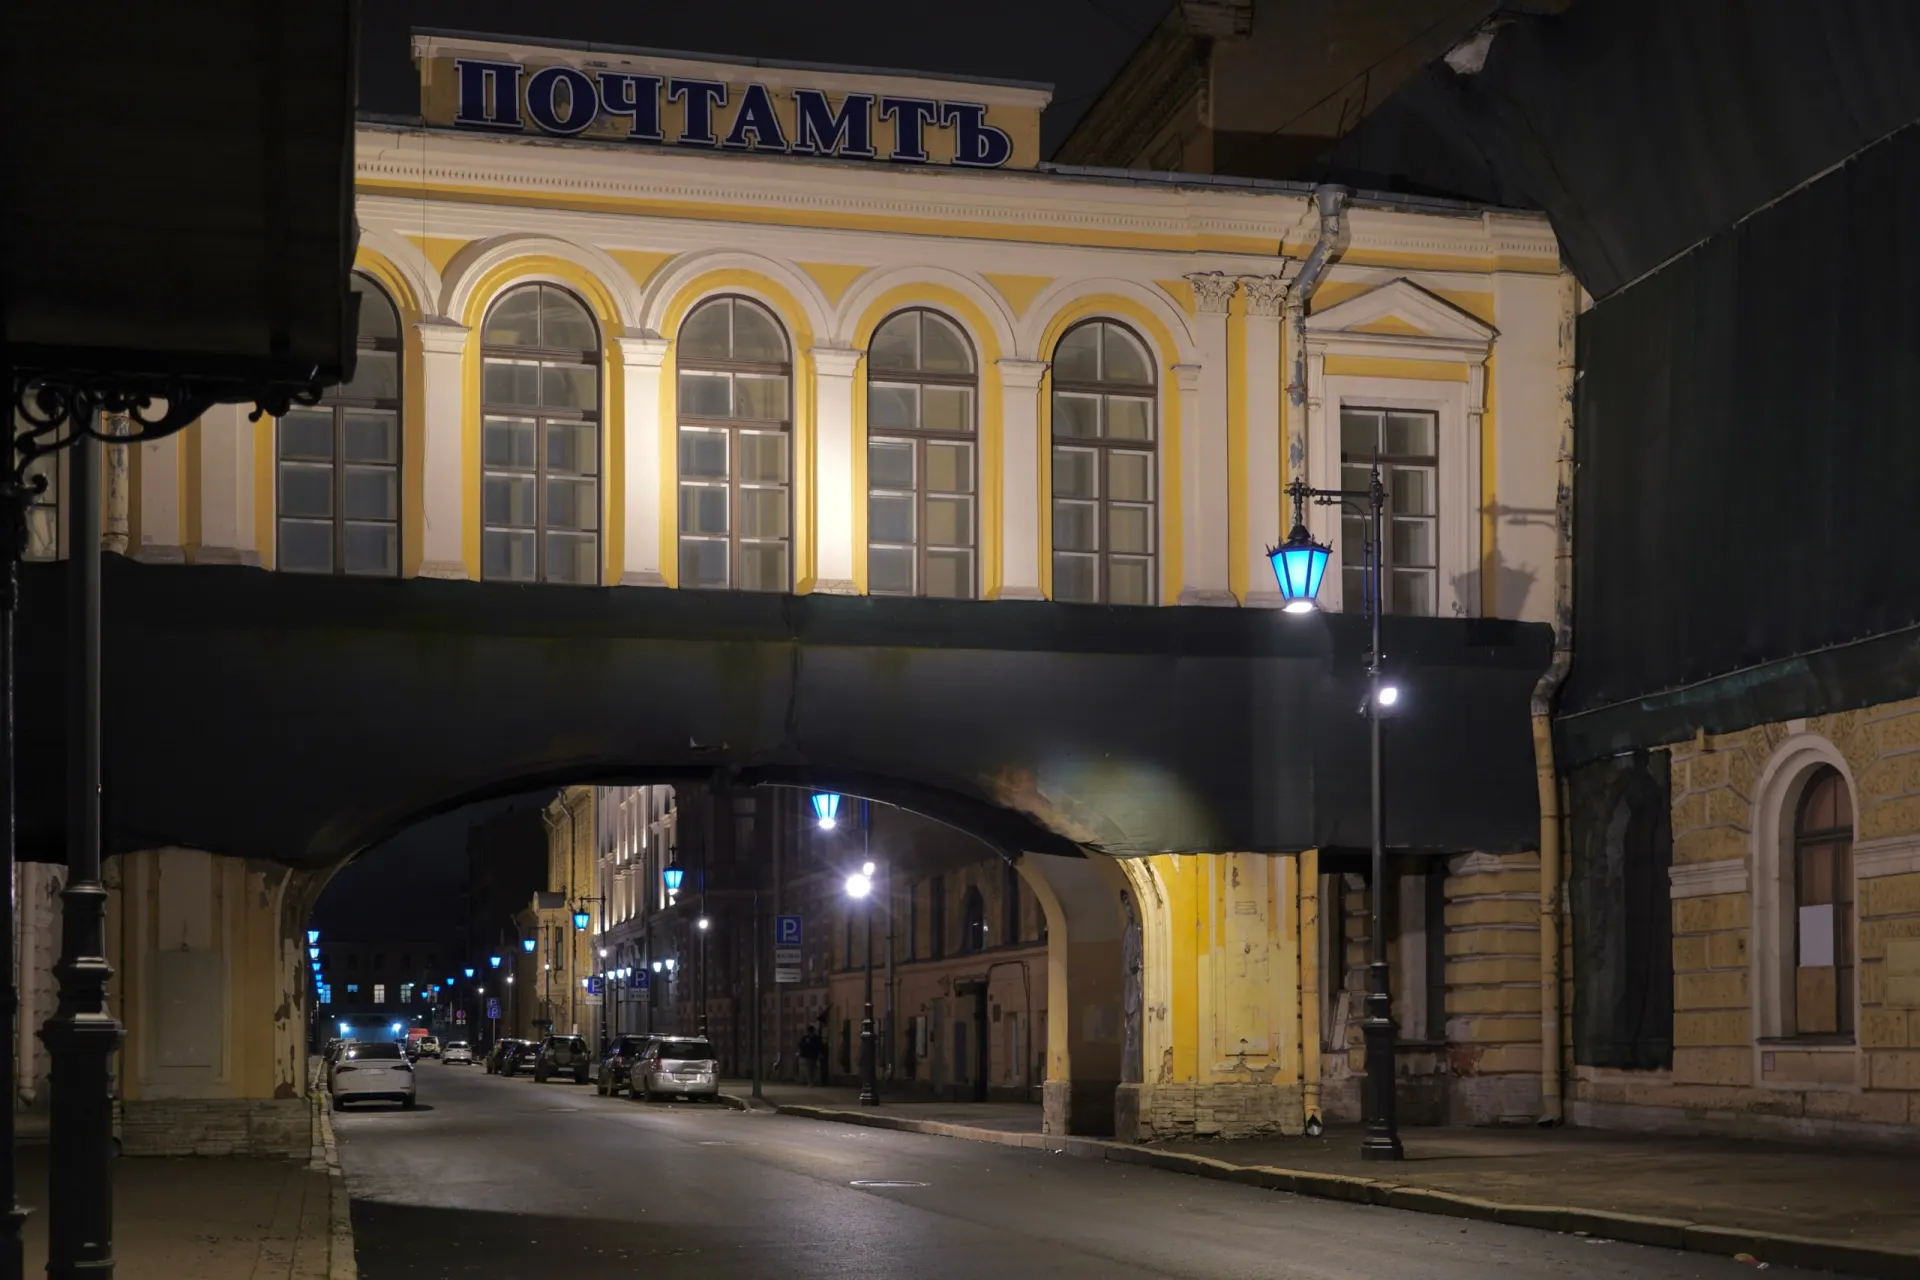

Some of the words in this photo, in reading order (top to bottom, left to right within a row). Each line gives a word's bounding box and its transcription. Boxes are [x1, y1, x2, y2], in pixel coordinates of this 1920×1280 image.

[454, 58, 1013, 168] ПОЧТАМТЪ
[783, 918, 797, 941] P
[591, 978, 602, 992] P
[635, 970, 647, 987] P
[491, 1007, 499, 1017] P
